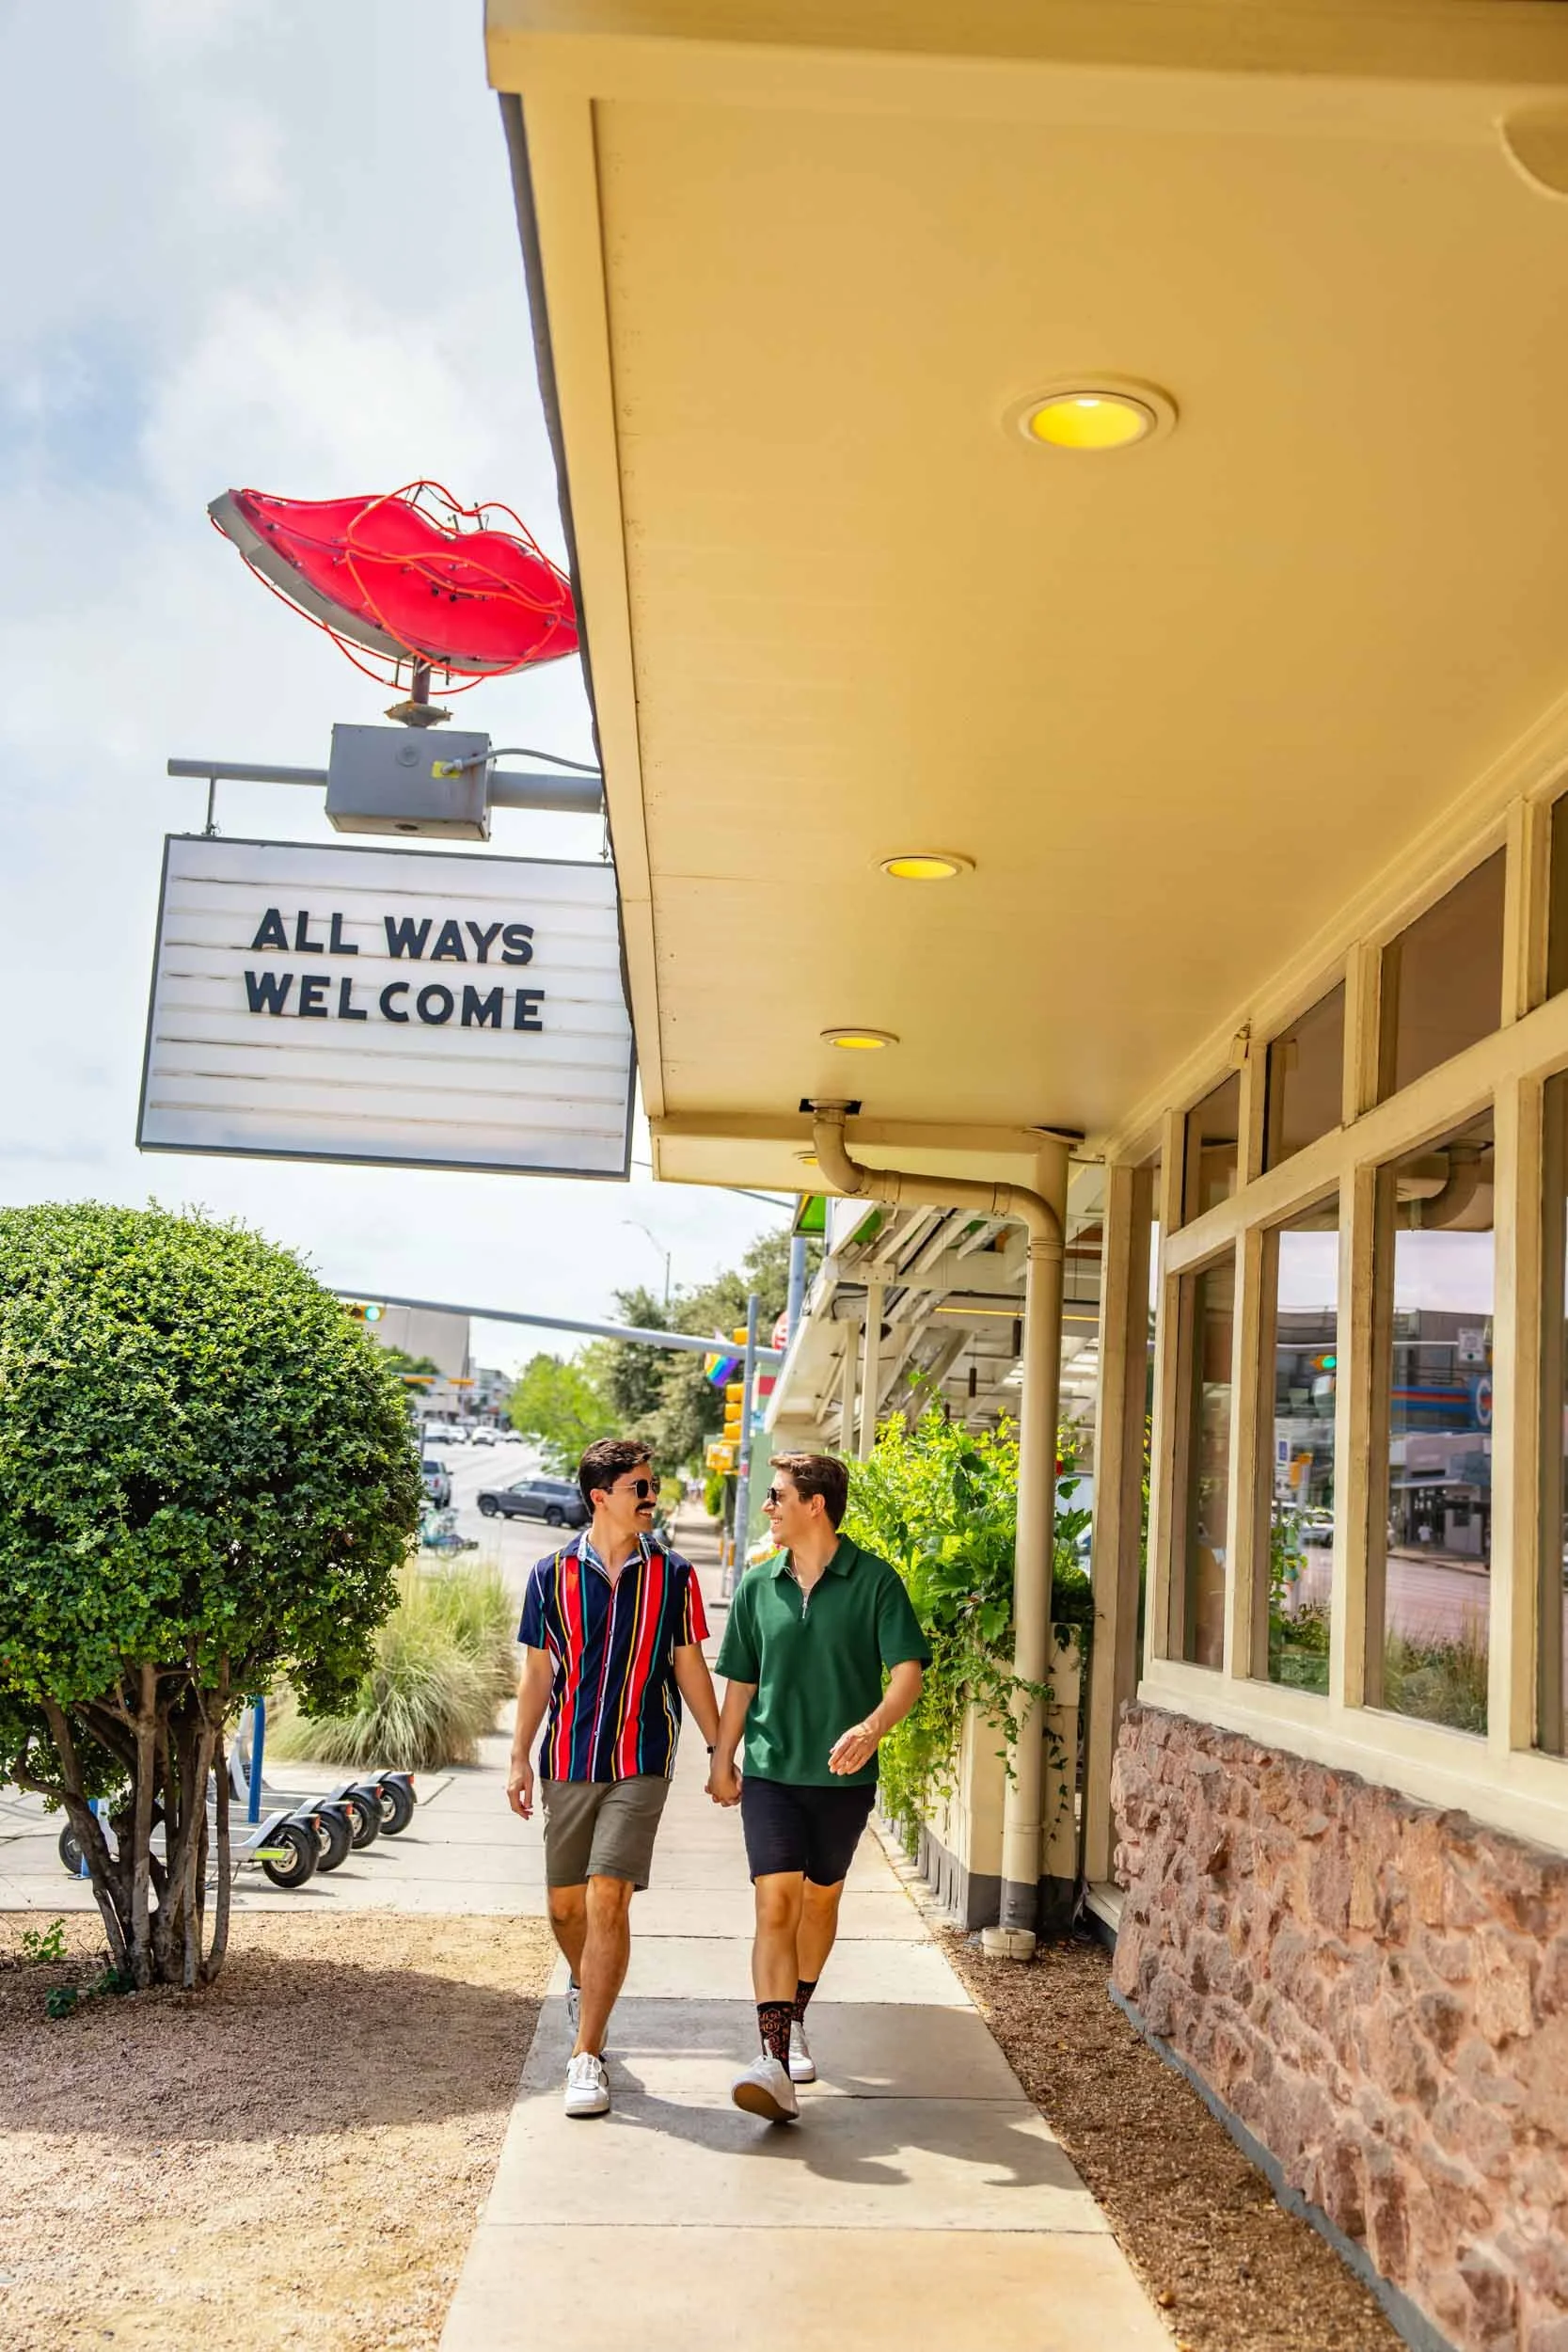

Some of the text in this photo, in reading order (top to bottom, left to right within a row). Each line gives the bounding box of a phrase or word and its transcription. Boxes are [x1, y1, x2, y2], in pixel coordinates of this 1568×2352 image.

[251, 908, 534, 965] ALL WAYS
[244, 970, 545, 1032] WELCOME
